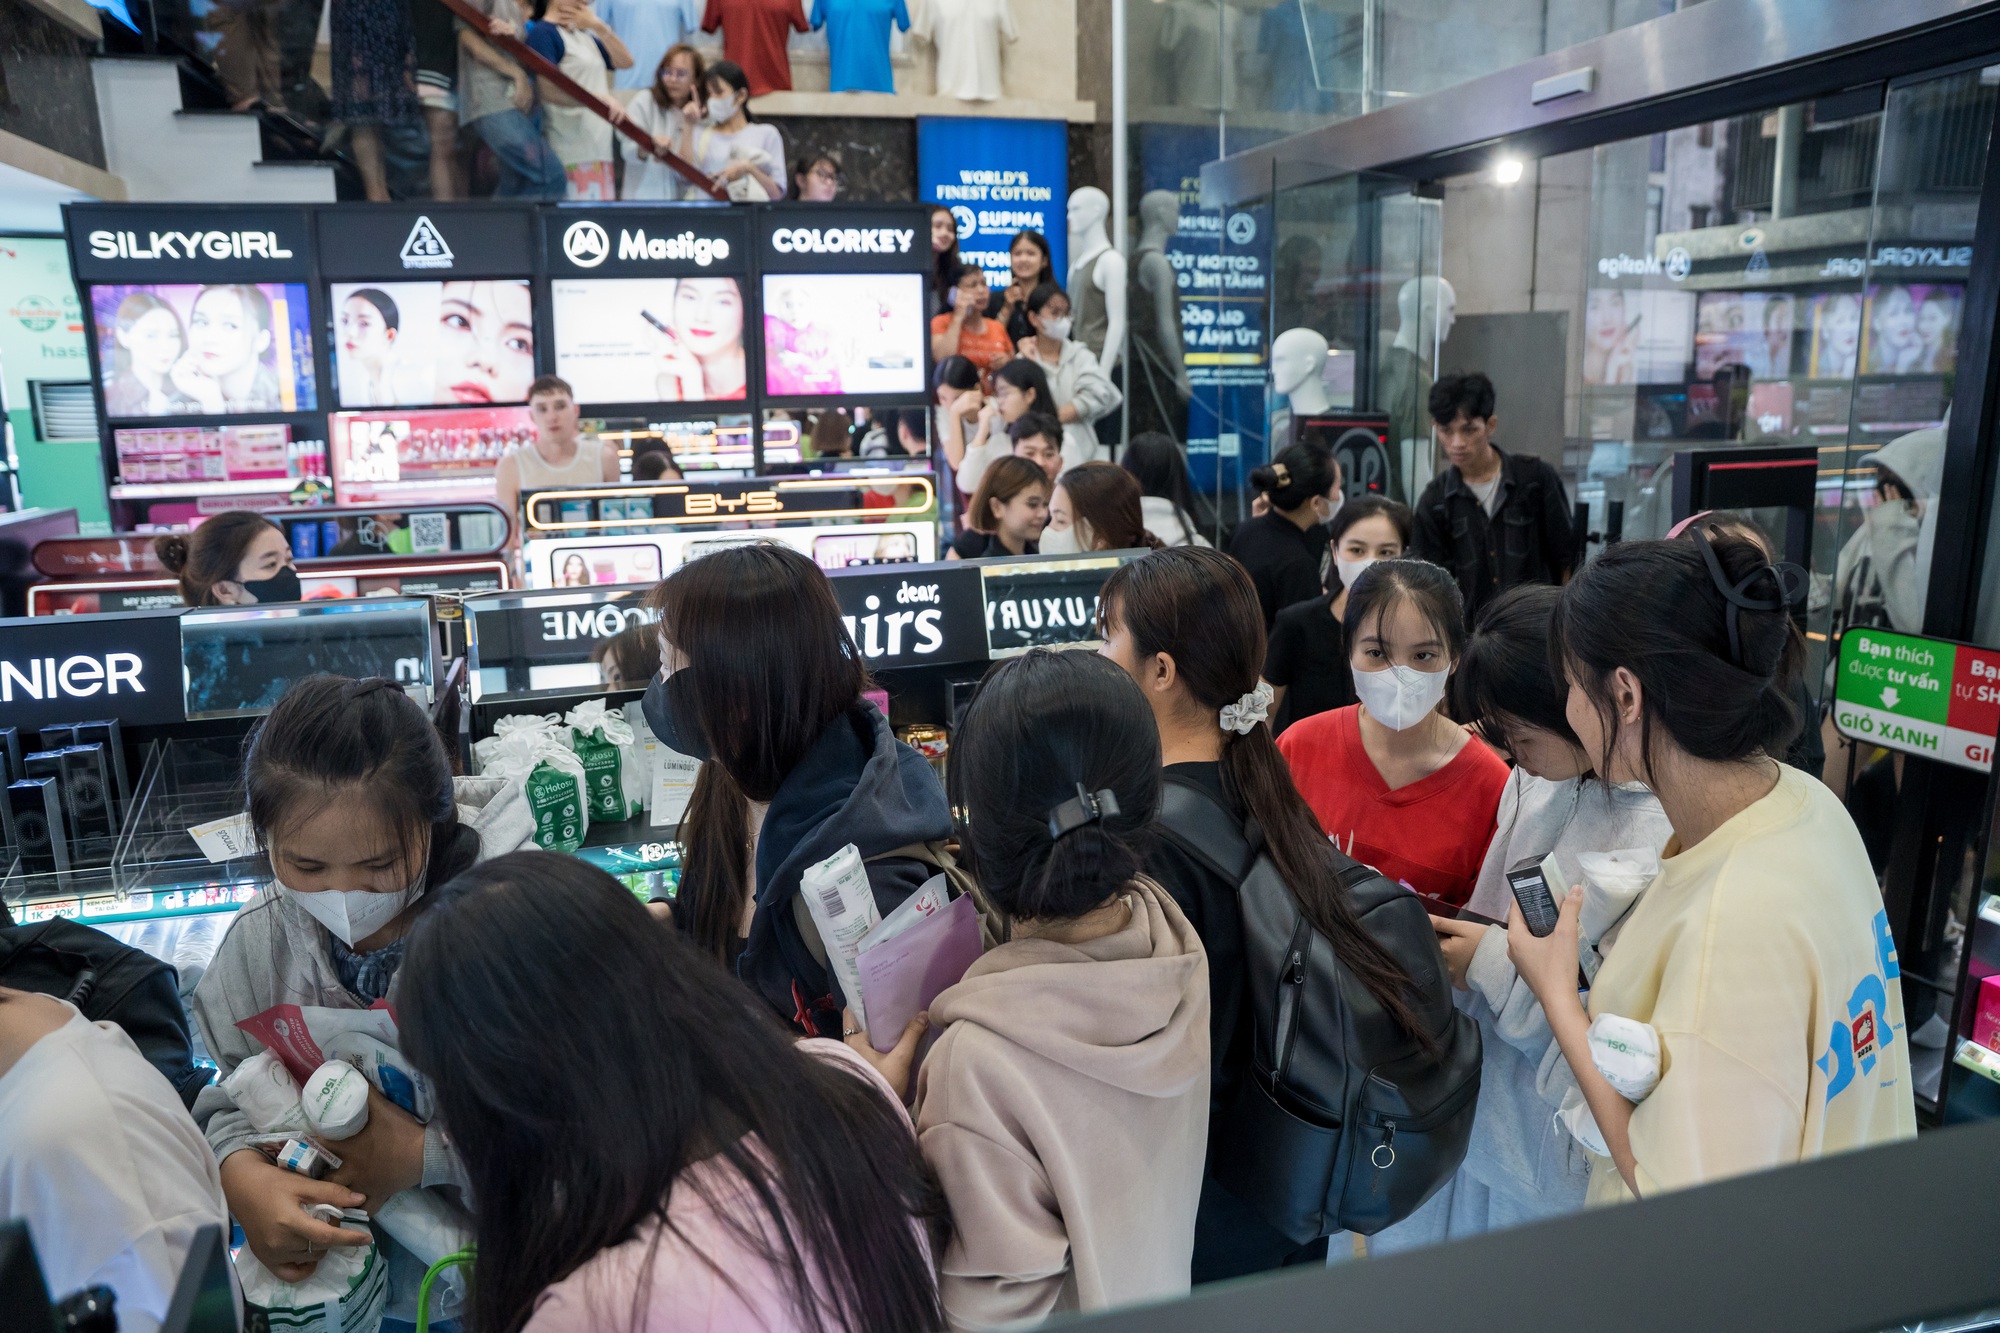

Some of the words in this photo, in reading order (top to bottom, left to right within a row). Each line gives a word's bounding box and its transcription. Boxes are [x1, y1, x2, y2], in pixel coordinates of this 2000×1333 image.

[960, 170, 1029, 186] WORLD'S
[936, 185, 989, 201] FINEST
[990, 186, 1052, 201] COTTON
[978, 211, 1044, 228] SUPIMA
[88, 230, 293, 260] SILKYGIRL
[618, 228, 730, 266] Mastige
[772, 227, 914, 254] COLORKEY
[897, 580, 941, 604] dear,
[1858, 637, 1891, 660] Bạn
[1895, 645, 1934, 667] thích
[1849, 659, 1885, 681] được
[1887, 667, 1908, 684] tư
[1909, 671, 1940, 692] vấn
[1839, 712, 1874, 733] GIỎ
[1878, 722, 1939, 751] XANH
[582, 750, 614, 761] Hotosu
[1965, 744, 1994, 765] GI
[664, 761, 695, 772] LUMINOUS
[545, 779, 573, 794] Hotosu
[31, 911, 43, 920] 1K
[34, 903, 54, 911] DEAL
[1607, 1038, 1627, 1053] 150
[321, 1077, 338, 1096] 150
